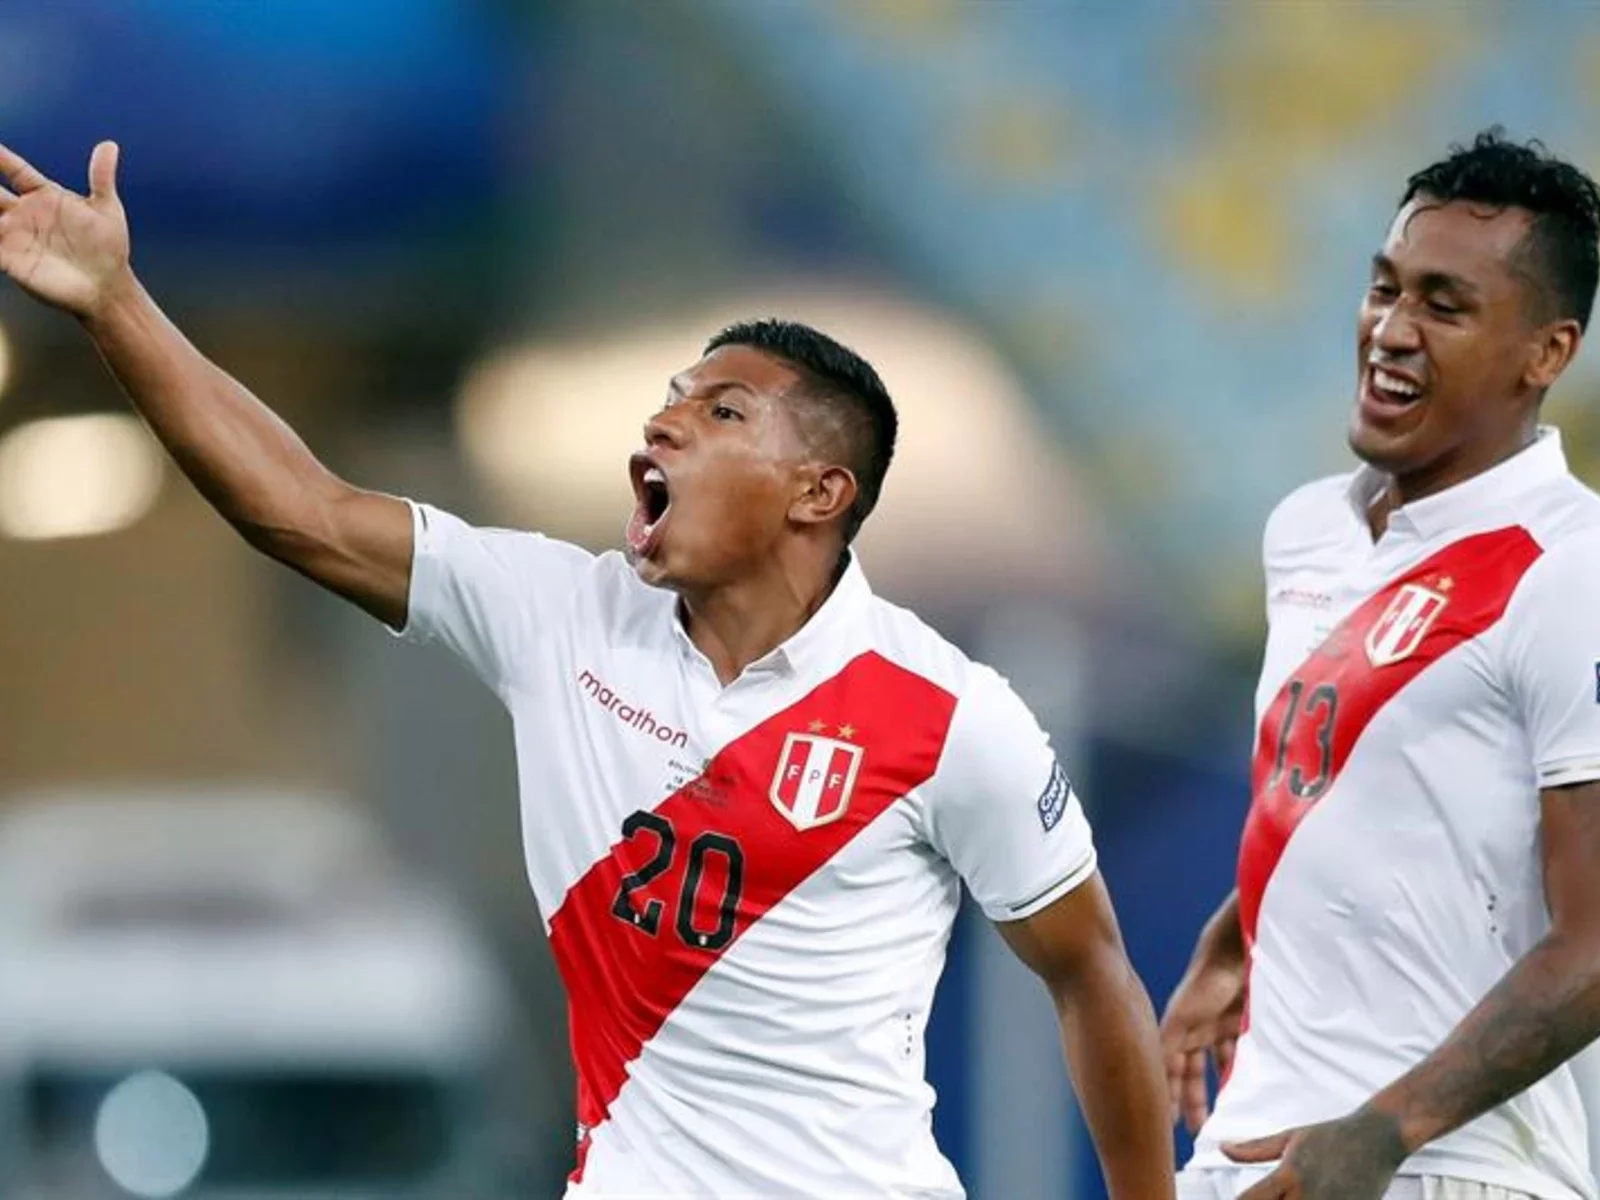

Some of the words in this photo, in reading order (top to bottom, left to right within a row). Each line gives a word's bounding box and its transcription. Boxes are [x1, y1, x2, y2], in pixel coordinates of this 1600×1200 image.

[579, 670, 688, 748] marathon
[1264, 680, 1338, 799] 13
[787, 764, 842, 789] FPF
[611, 809, 745, 951] 20
